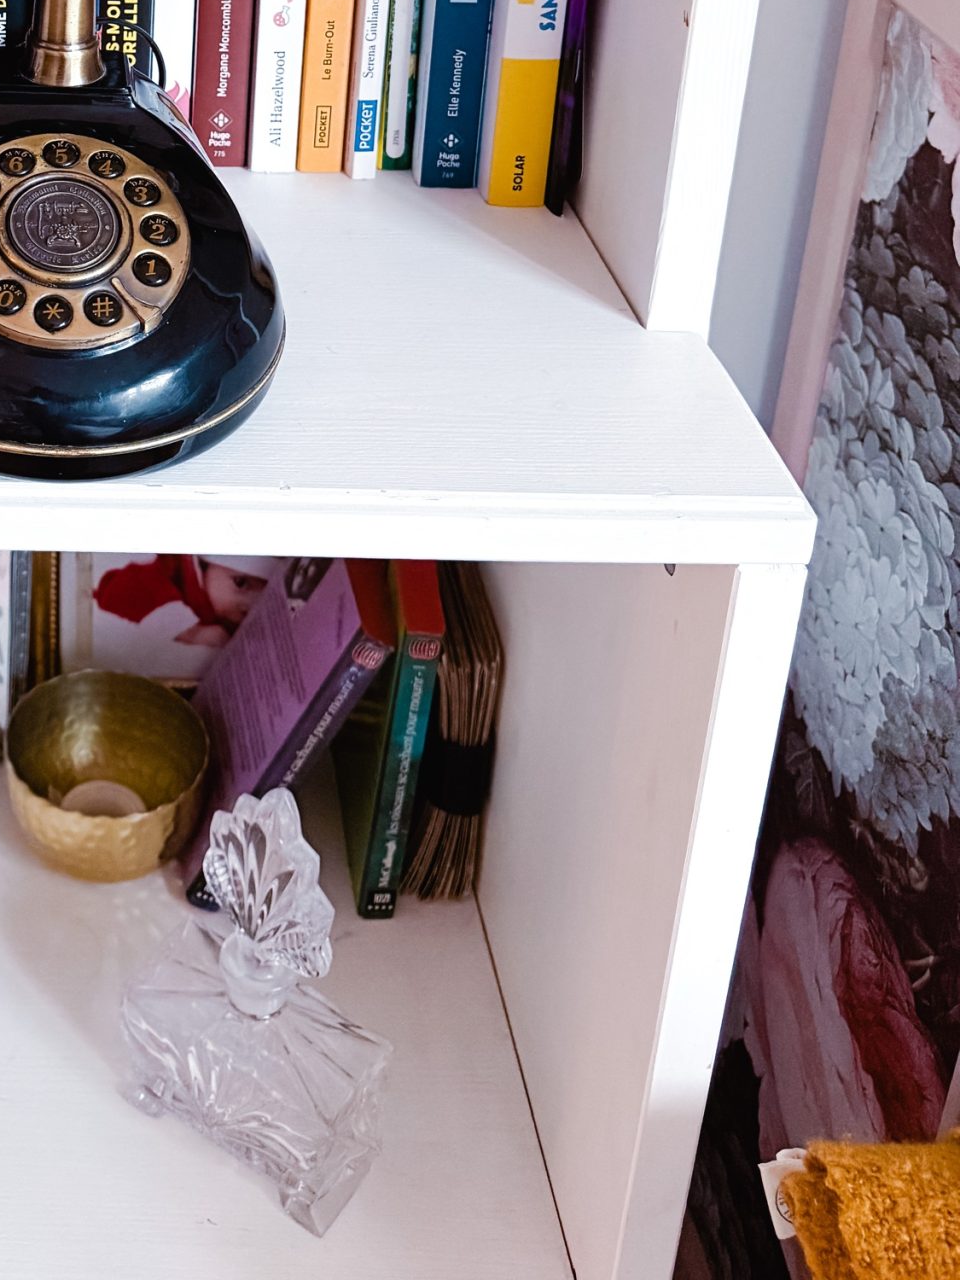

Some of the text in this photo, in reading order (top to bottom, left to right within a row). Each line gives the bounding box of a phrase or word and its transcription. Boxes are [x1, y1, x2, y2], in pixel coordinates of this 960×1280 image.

[322, 20, 336, 81] Le Burn-Out
[363, 43, 375, 79] Serena
[216, 53, 230, 97] Morgane
[447, 49, 466, 117] Elle Kennedy
[270, 50, 286, 147] Ali Hazelwood
[210, 130, 231, 140] Hugo
[318, 110, 329, 144] POCKET
[359, 102, 375, 150] POCKET
[208, 138, 232, 147] Poche
[8, 156, 23, 171] 6
[55, 149, 68, 164] 5
[437, 160, 460, 168] Poche
[439, 152, 460, 161] Hugo
[98, 159, 113, 175] 4
[512, 154, 525, 191] SOLAR
[133, 187, 148, 202] 3
[149, 224, 166, 239] 2
[145, 260, 156, 276] 1
[404, 712, 420, 736] pour
[396, 735, 414, 774] cachent
